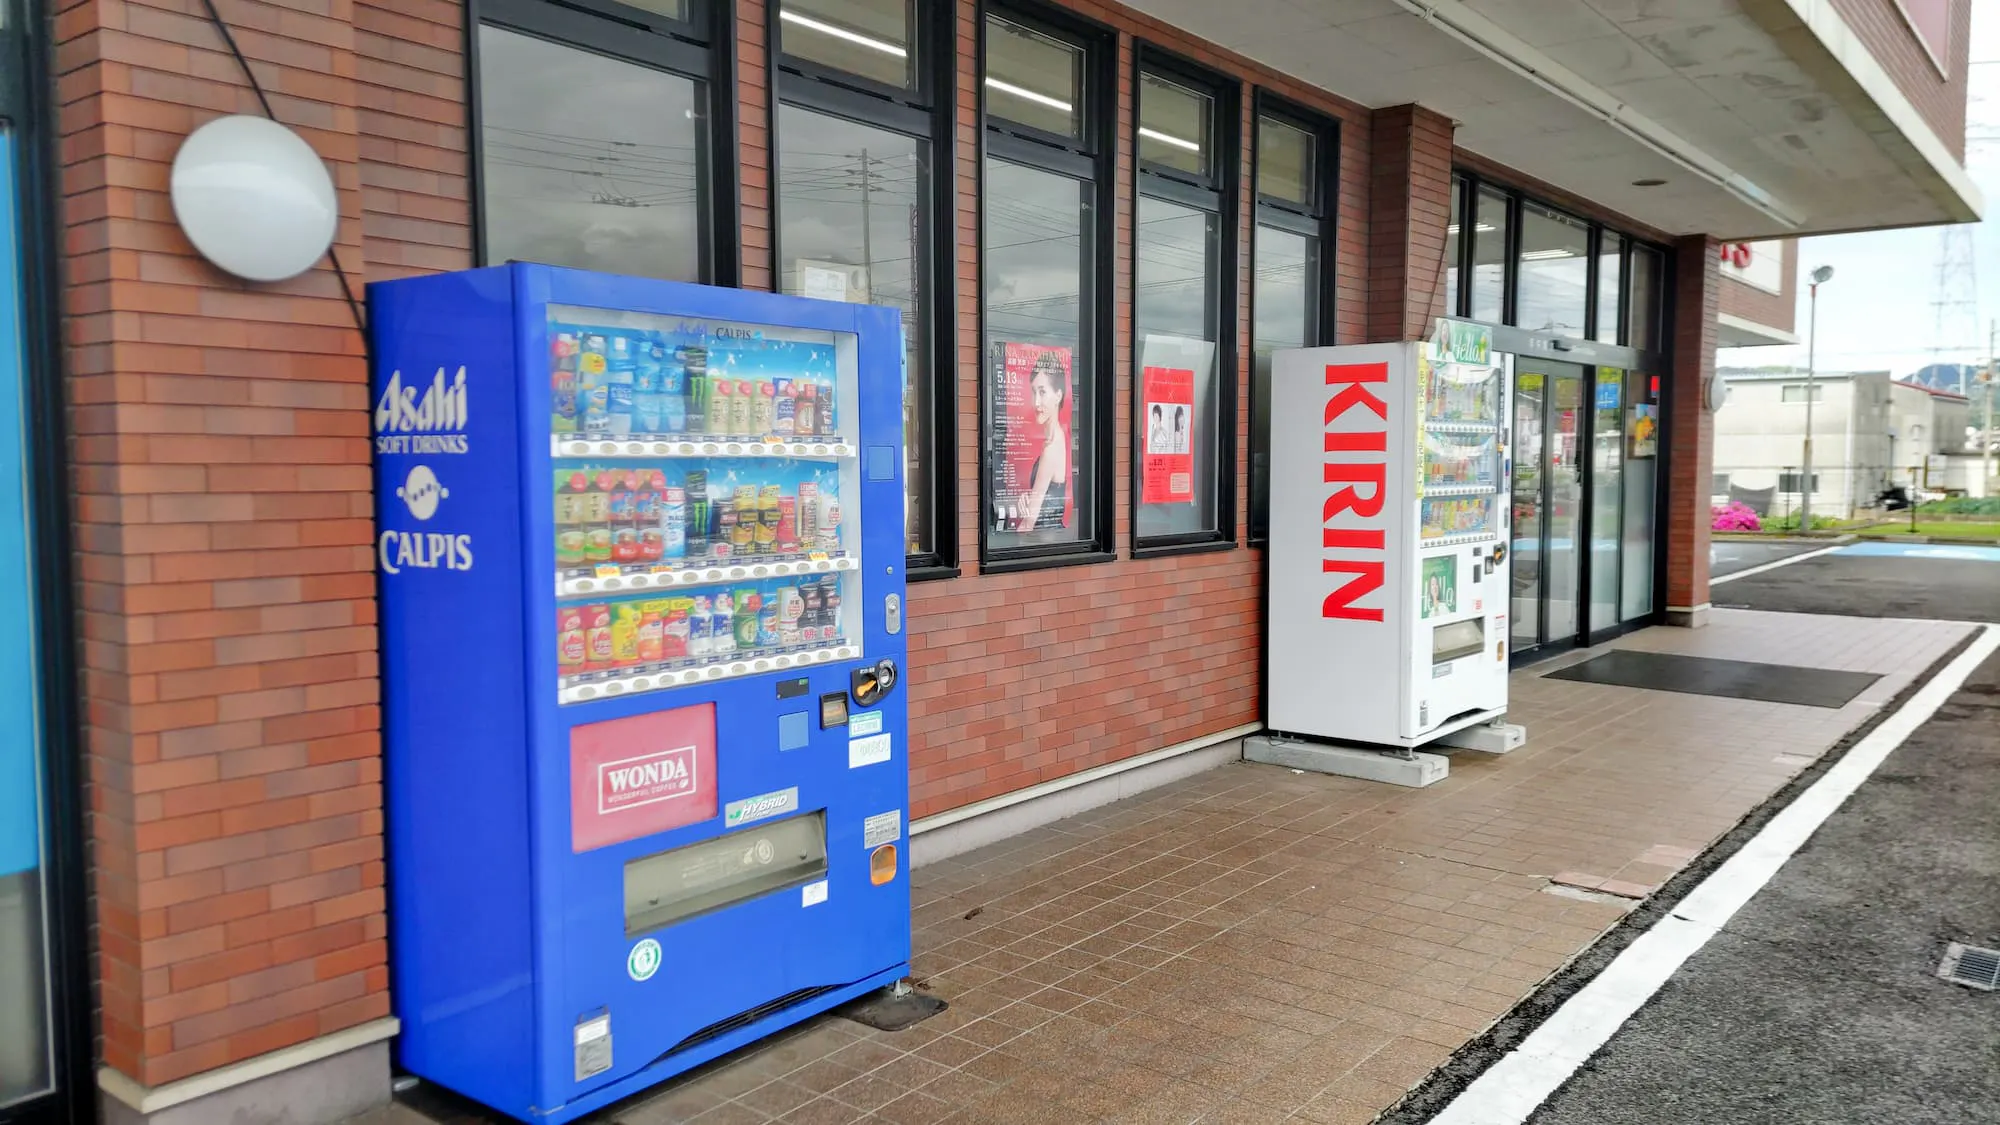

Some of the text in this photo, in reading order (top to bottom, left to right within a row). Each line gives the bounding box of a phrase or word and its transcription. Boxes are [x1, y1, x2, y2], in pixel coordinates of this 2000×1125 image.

[715, 327, 752, 341] CALPIS
[996, 371, 1017, 385] 5.13
[375, 365, 468, 432] Asahi
[376, 434, 468, 454] SOFT DRINKS
[1322, 361, 1388, 622] KIRIN
[379, 529, 473, 575] CALPIS
[607, 756, 689, 793] WONDA
[739, 794, 788, 821] HYBRID
